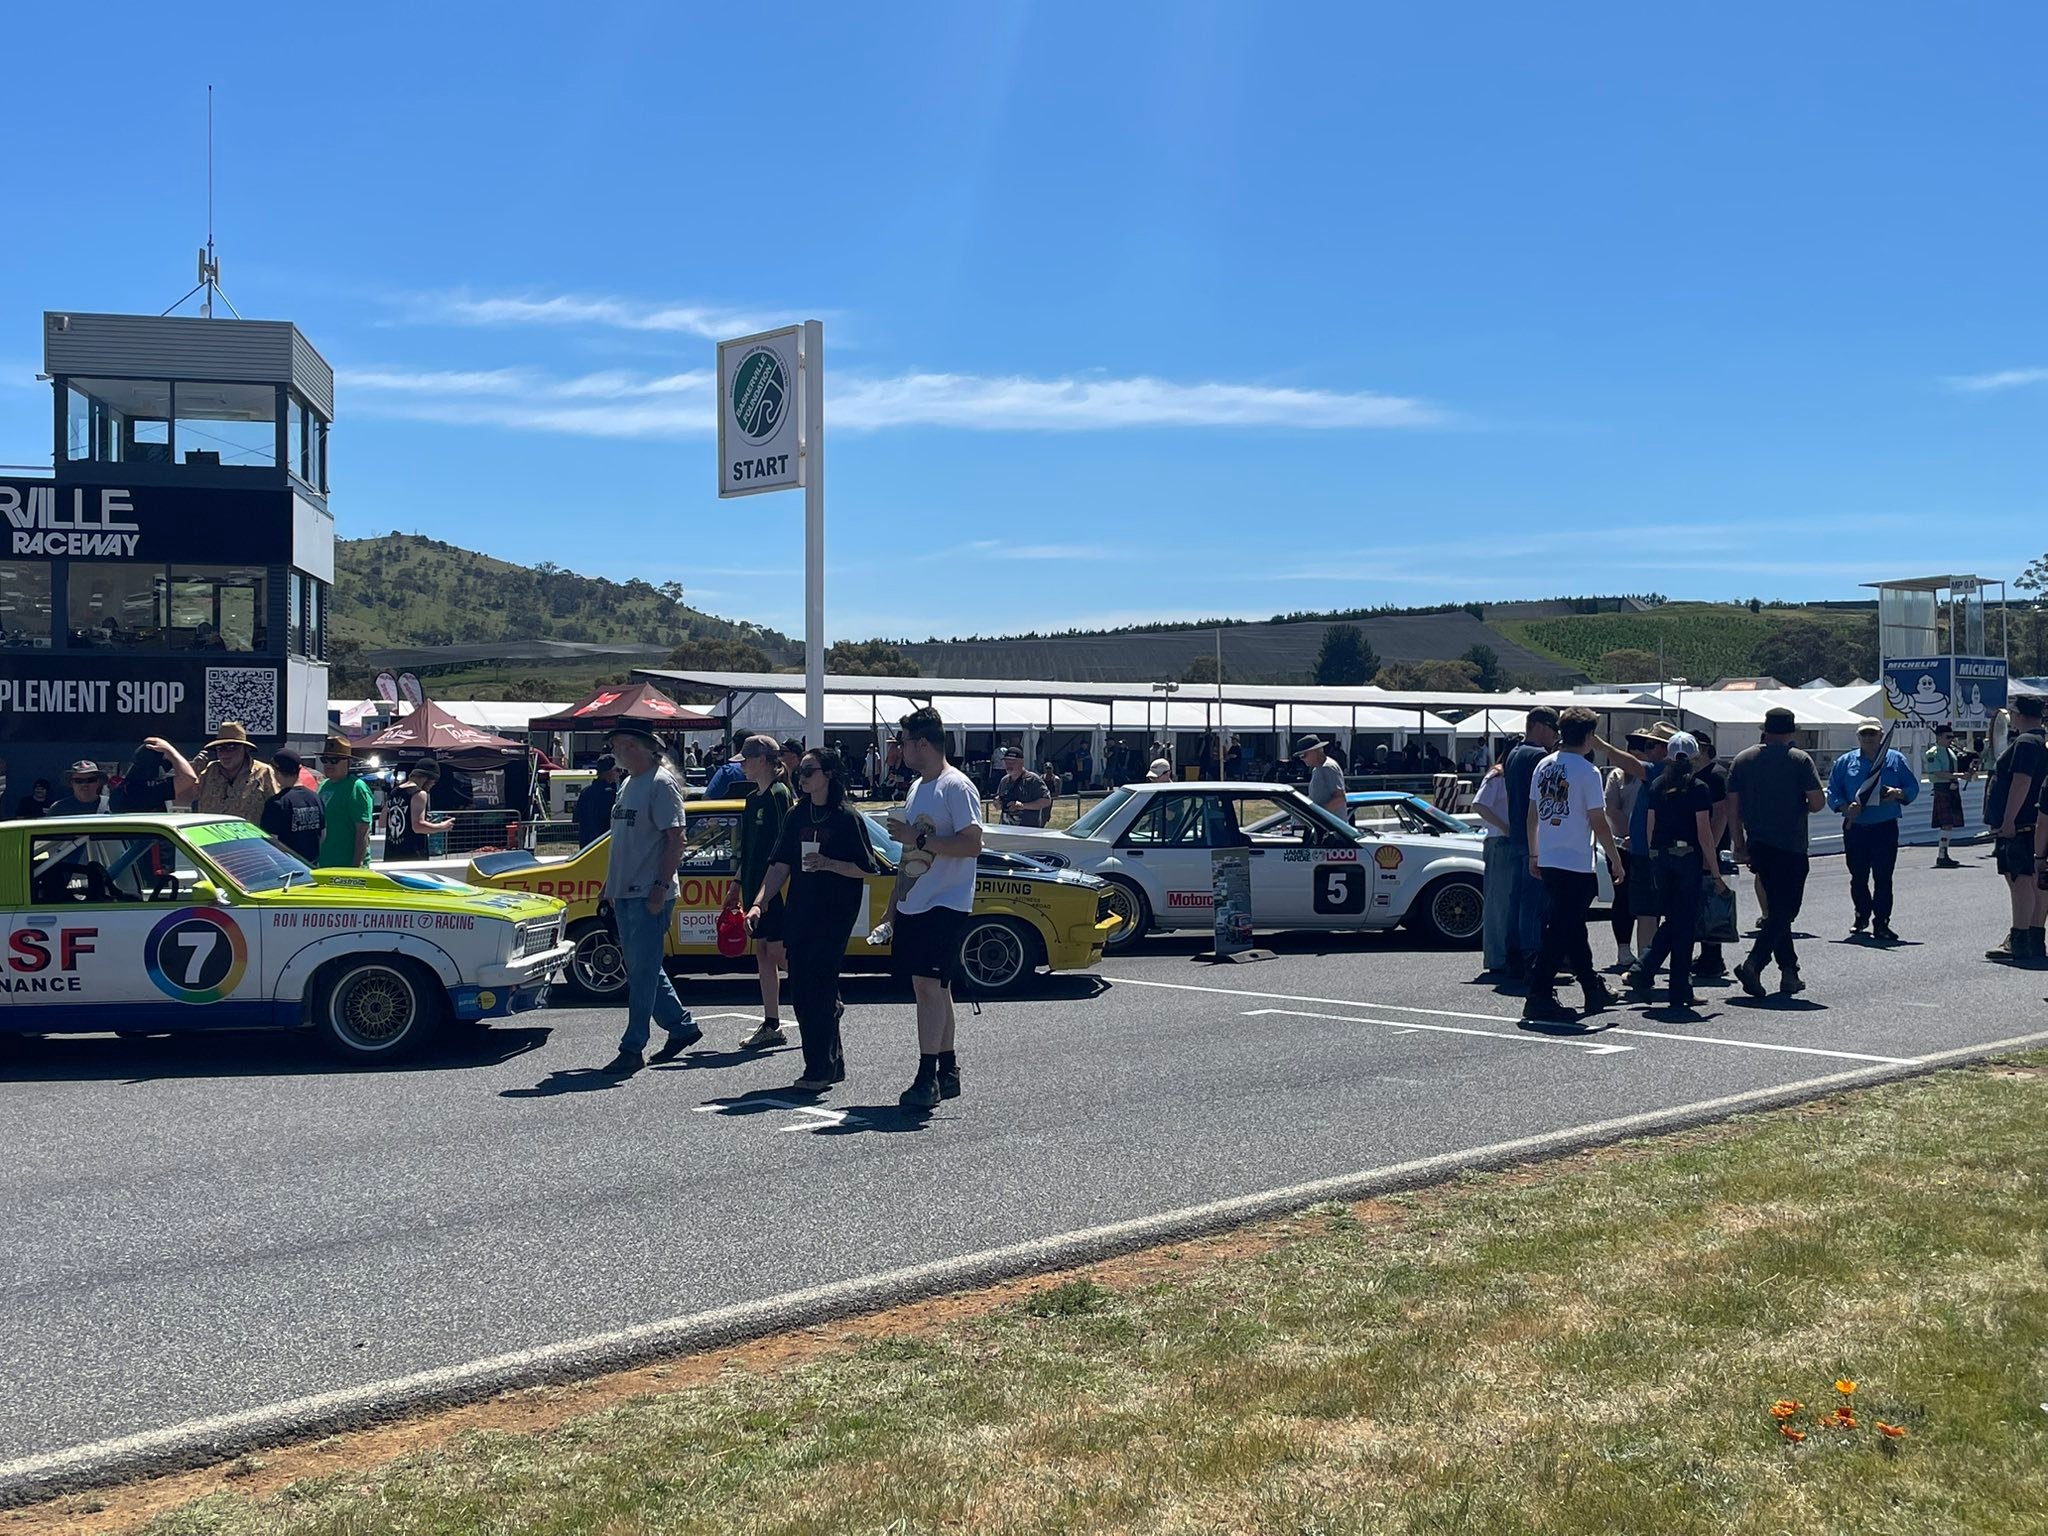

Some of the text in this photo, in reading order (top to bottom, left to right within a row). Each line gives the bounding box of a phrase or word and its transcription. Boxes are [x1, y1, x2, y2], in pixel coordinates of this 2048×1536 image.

[736, 354, 768, 418] BASKERVILLE
[743, 363, 773, 423] FOUNDATION
[733, 454, 789, 481] START
[12, 531, 140, 556] RACEWAY
[1951, 581, 1963, 590] MP
[1887, 660, 1939, 669] MICHELIN
[1959, 663, 2006, 677] MICHELIN
[0, 680, 185, 714] PLEMENT SHOP
[1327, 849, 1355, 860] 1000
[333, 876, 360, 886] Castrol
[975, 881, 1032, 895] DRIVING
[1327, 872, 1348, 904] 5
[273, 912, 298, 928] RON
[435, 915, 475, 930] RACING
[0, 928, 98, 972] SF
[177, 931, 217, 984] 7
[0, 977, 82, 993] NANCE
